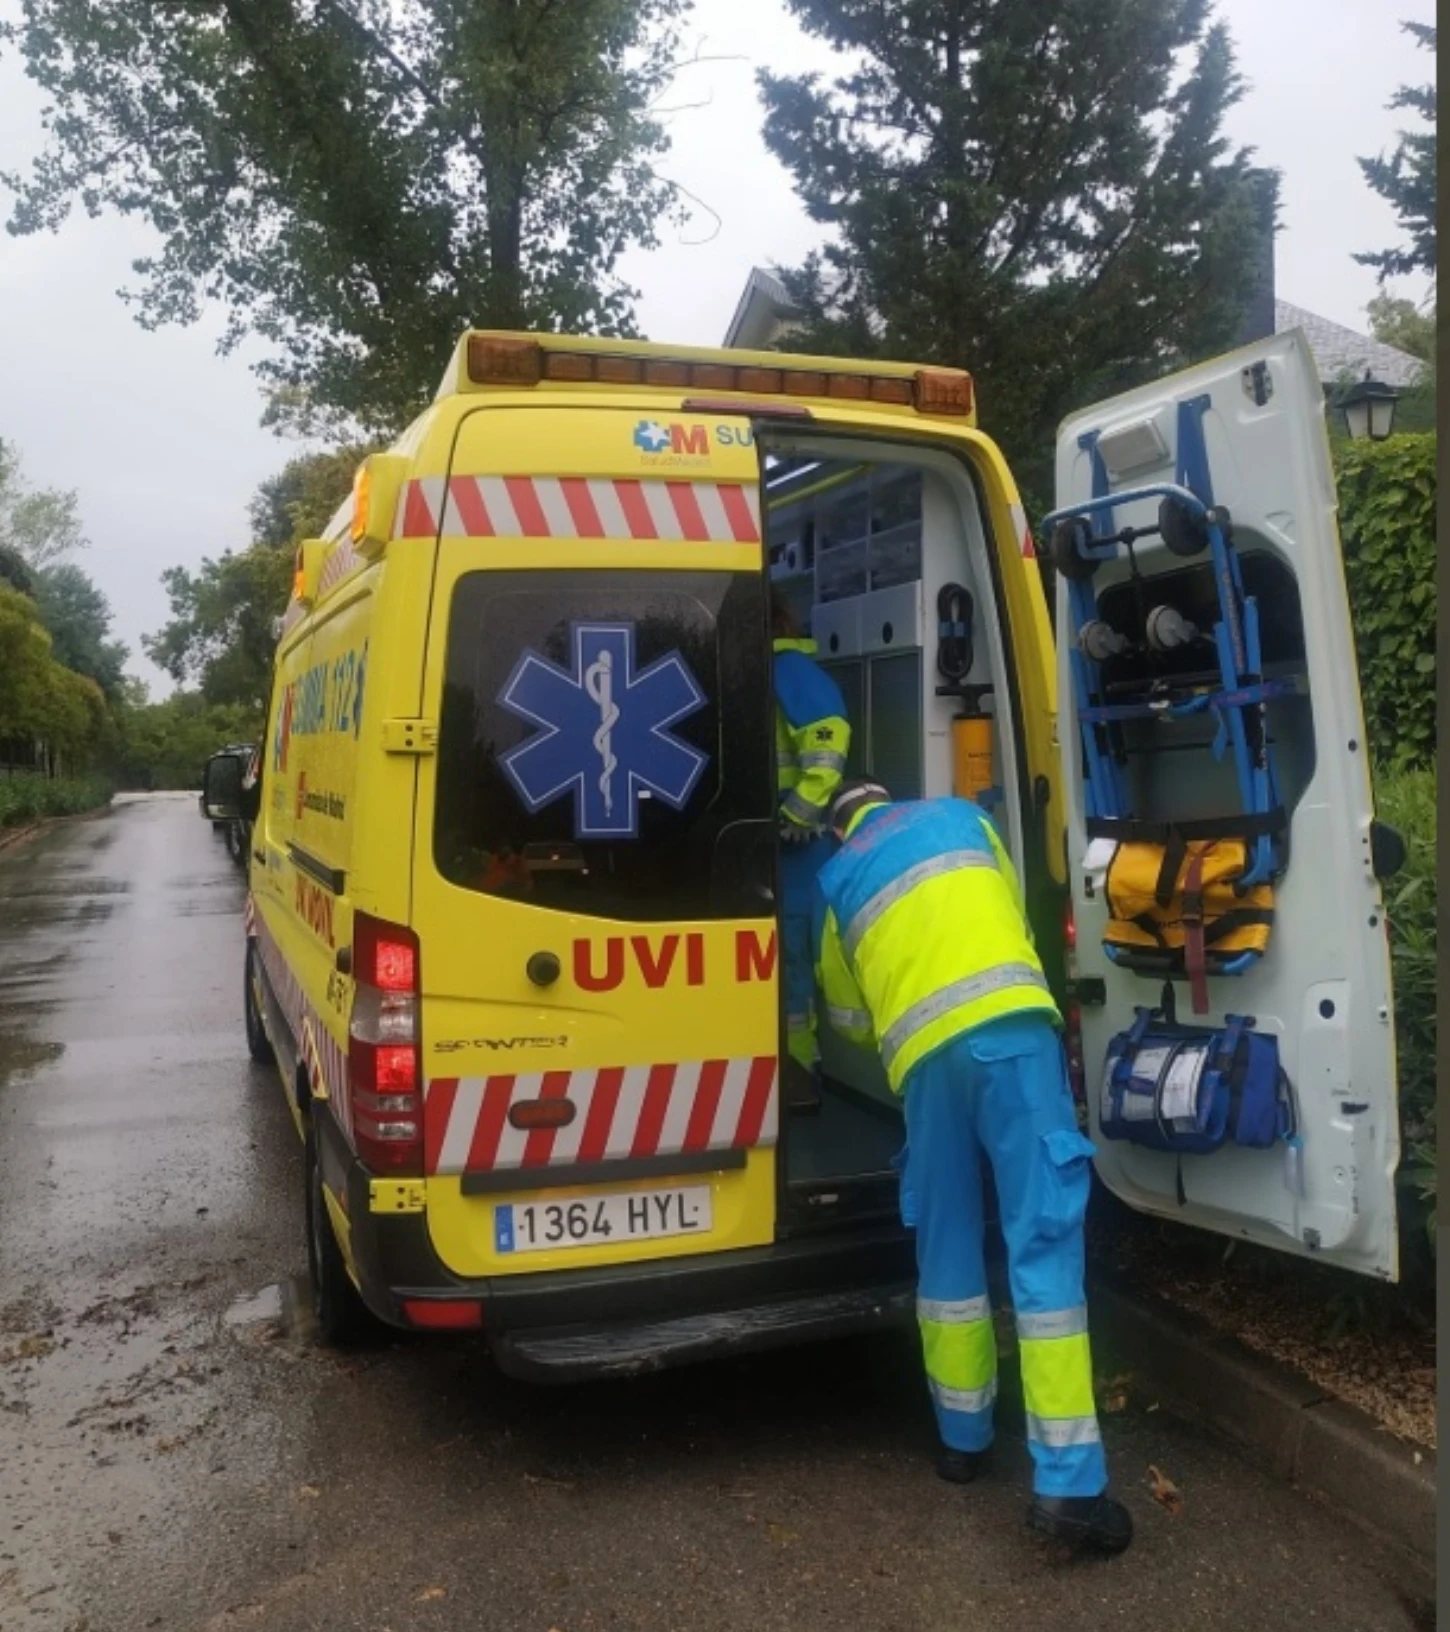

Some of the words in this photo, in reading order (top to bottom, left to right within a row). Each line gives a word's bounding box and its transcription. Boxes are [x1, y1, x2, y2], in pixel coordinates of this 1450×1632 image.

[669, 423, 710, 456] M
[573, 932, 705, 993] UVI
[735, 928, 777, 983] M
[523, 1201, 612, 1243] 1364
[628, 1193, 698, 1233] HYL
